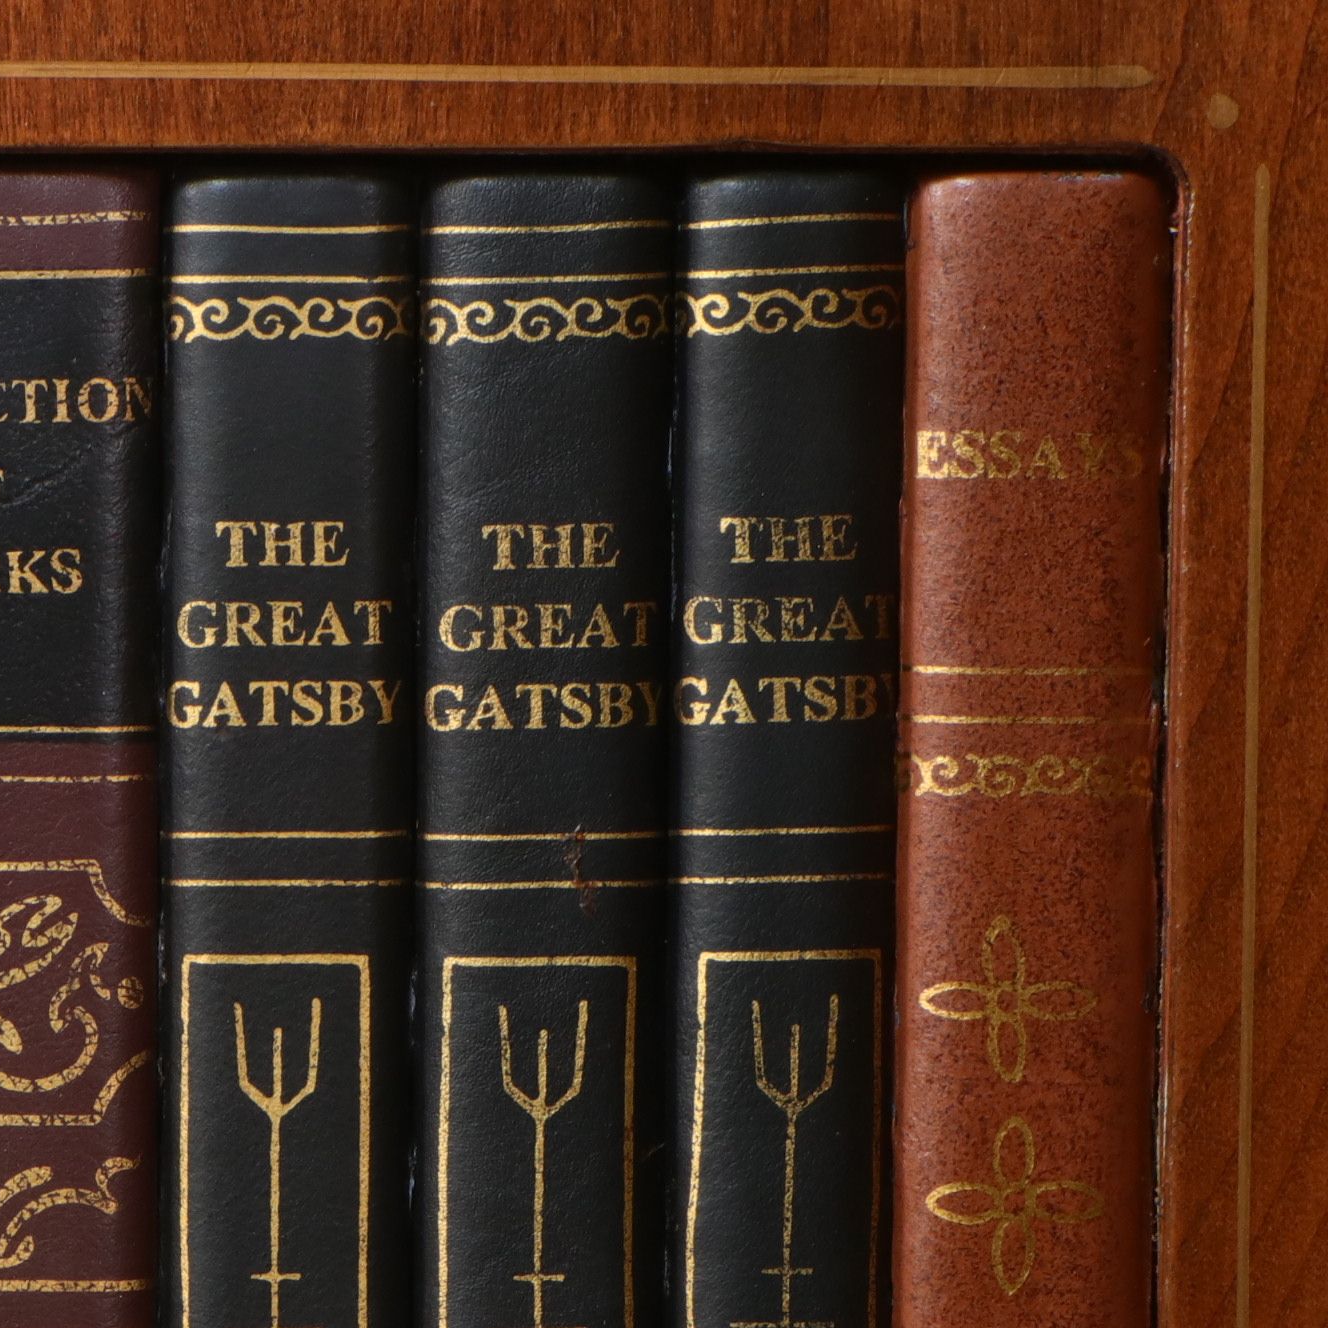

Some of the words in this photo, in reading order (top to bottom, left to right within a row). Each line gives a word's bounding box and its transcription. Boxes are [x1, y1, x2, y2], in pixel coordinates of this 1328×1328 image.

[215, 521, 349, 567] THE
[482, 522, 619, 570] THE
[720, 514, 857, 564] THE
[177, 601, 391, 648] GREAT
[438, 601, 656, 653] GREAT
[683, 595, 895, 645] GREAT
[167, 680, 401, 728] GATSBY
[424, 680, 662, 732] GATSBY
